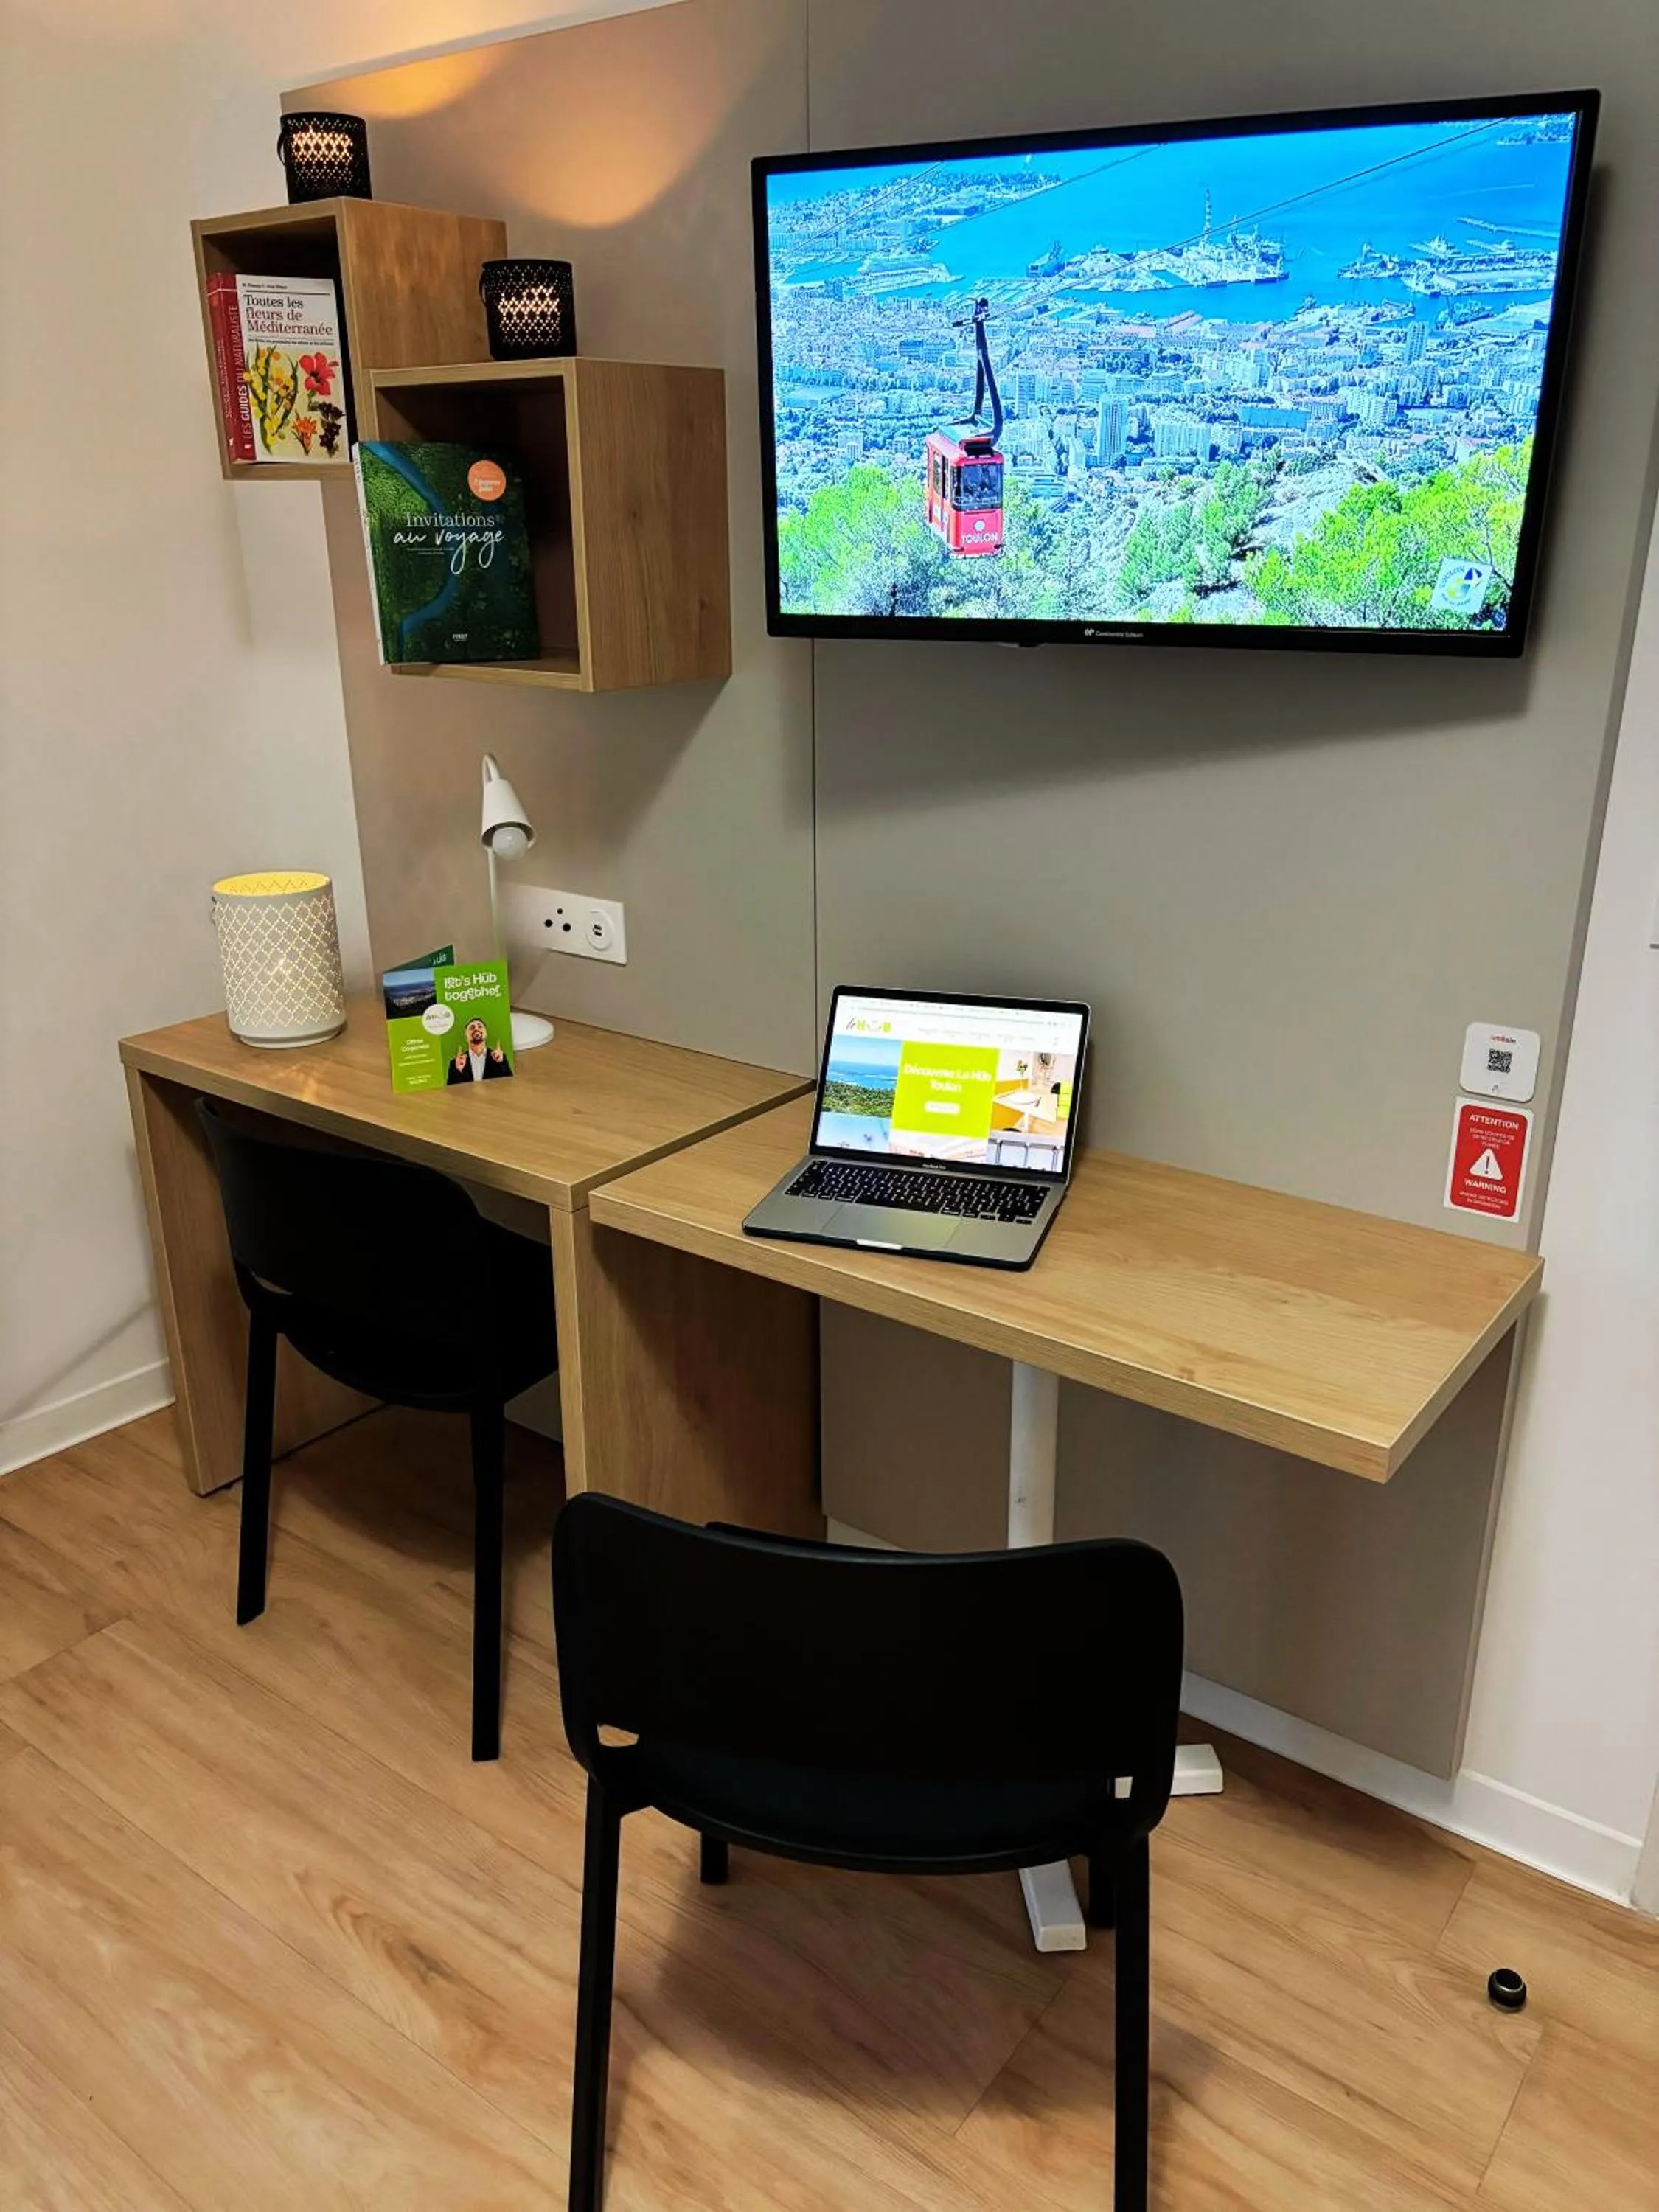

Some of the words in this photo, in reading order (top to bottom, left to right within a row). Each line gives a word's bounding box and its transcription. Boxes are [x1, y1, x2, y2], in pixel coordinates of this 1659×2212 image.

[243, 294, 284, 307] Toutes
[287, 296, 304, 308] les
[246, 307, 283, 320] fleurs
[287, 309, 303, 321] de
[247, 320, 333, 335] Méditerranée
[238, 386, 251, 421] GUIDES
[242, 423, 253, 439] LES
[406, 512, 495, 528] Invitations
[961, 532, 998, 544] TOULON
[393, 531, 428, 544] au
[434, 529, 505, 575] voyage
[1469, 1113, 1520, 1130] ATTENTION
[1464, 1178, 1507, 1194] WARNING
